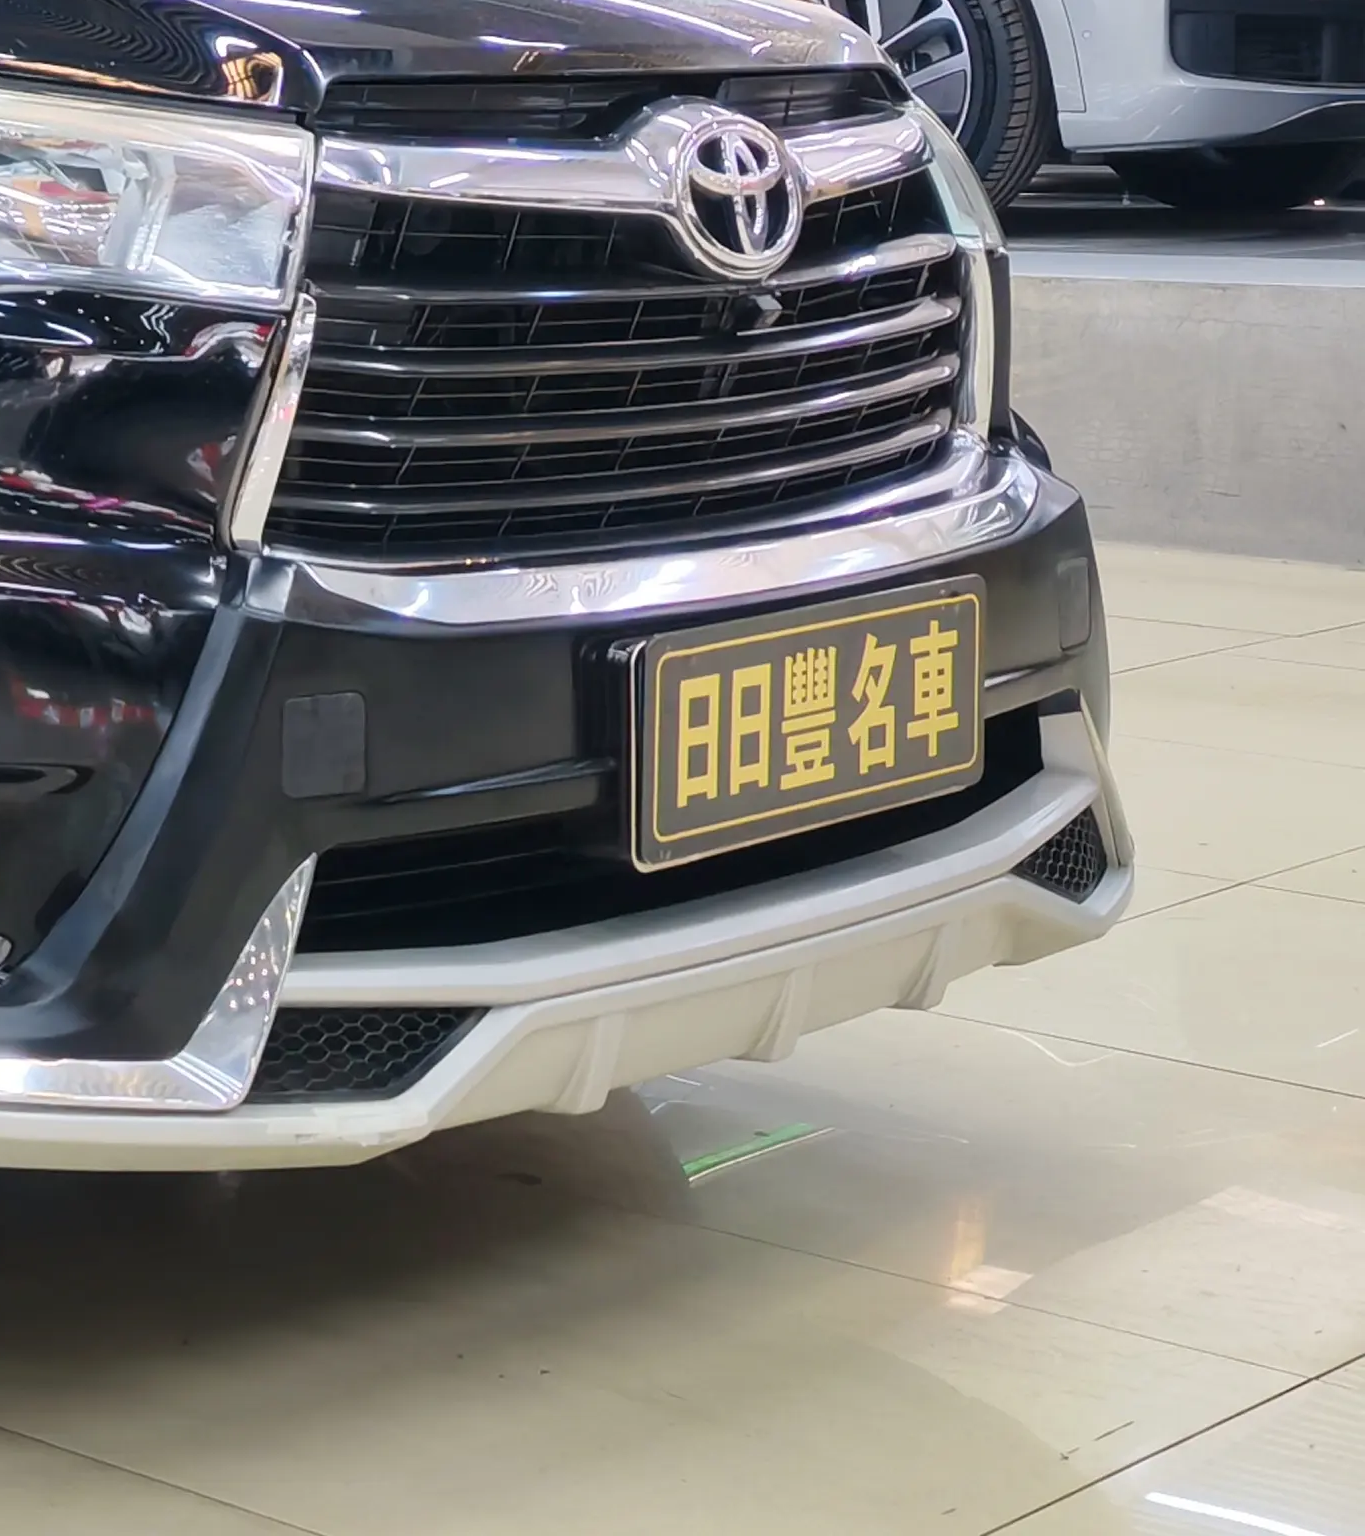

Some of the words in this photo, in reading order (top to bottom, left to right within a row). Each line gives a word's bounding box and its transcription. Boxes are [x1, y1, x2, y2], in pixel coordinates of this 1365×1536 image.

[676, 619, 959, 808] 日日豐名車
